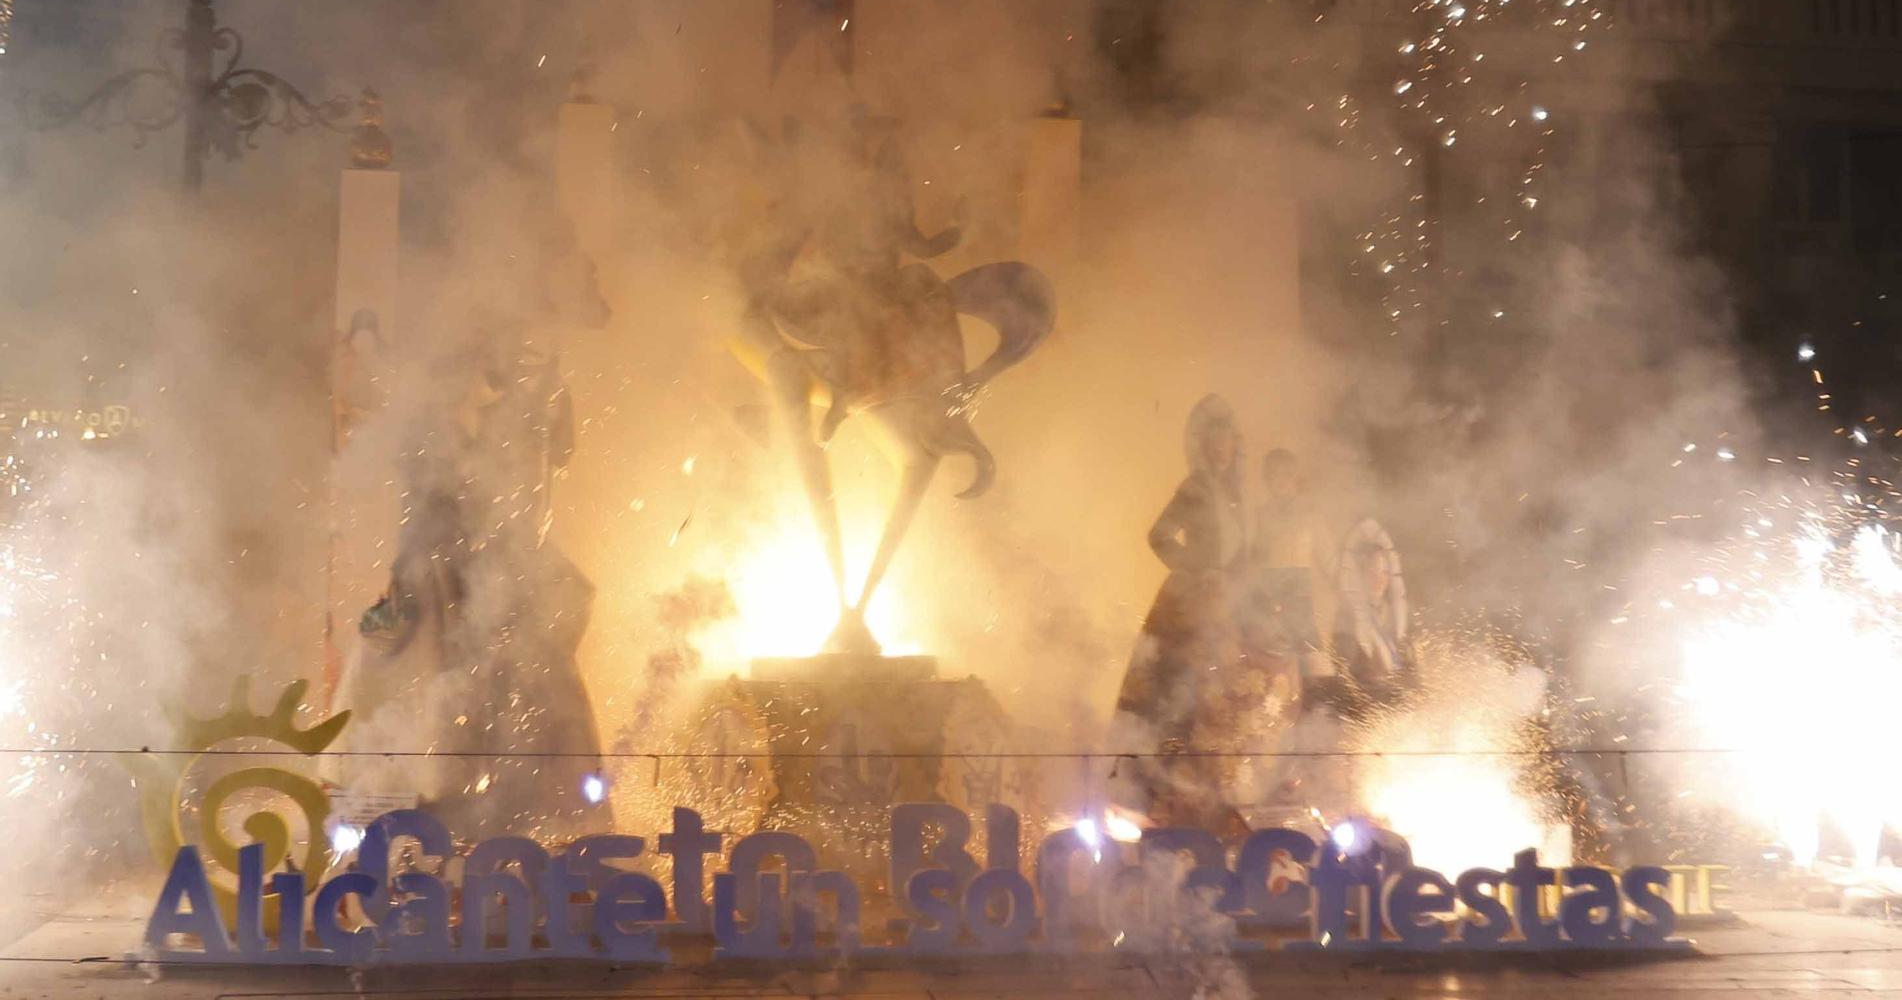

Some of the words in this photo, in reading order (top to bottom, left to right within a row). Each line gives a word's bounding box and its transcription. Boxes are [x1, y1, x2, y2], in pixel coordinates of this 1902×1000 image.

[144, 842, 668, 955] Alicante
[713, 868, 860, 955] un
[1308, 832, 1676, 948] fiestas
